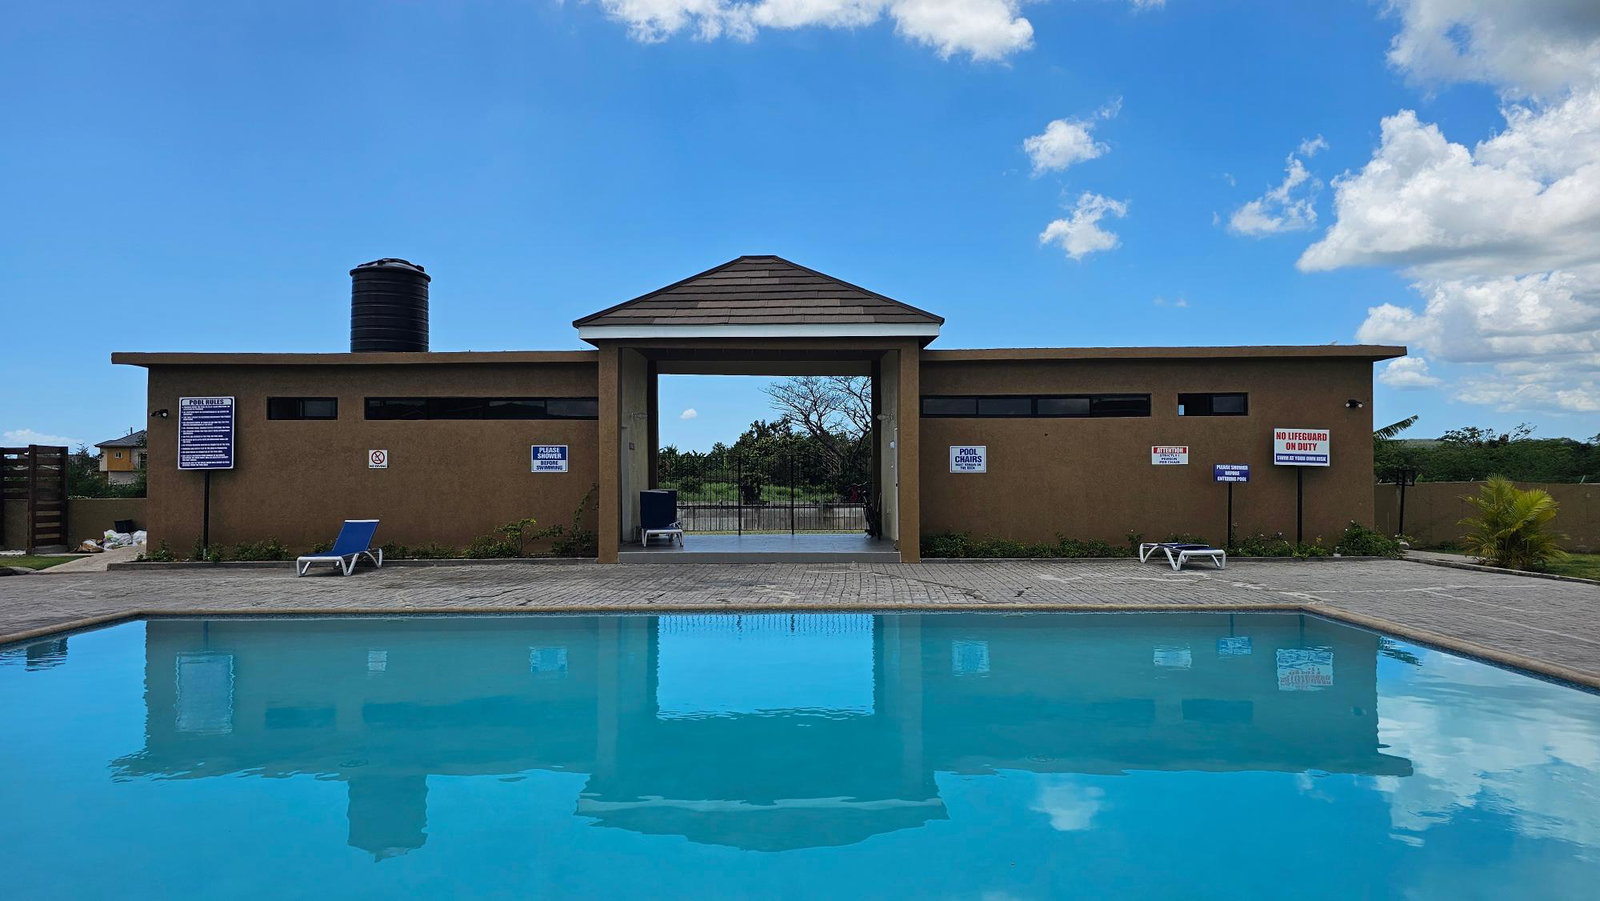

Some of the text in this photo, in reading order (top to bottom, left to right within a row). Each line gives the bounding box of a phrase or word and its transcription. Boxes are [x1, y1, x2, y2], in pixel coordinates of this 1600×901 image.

[1276, 432, 1327, 441] NO LIFEGUARD
[1286, 442, 1317, 451] ON DUTY
